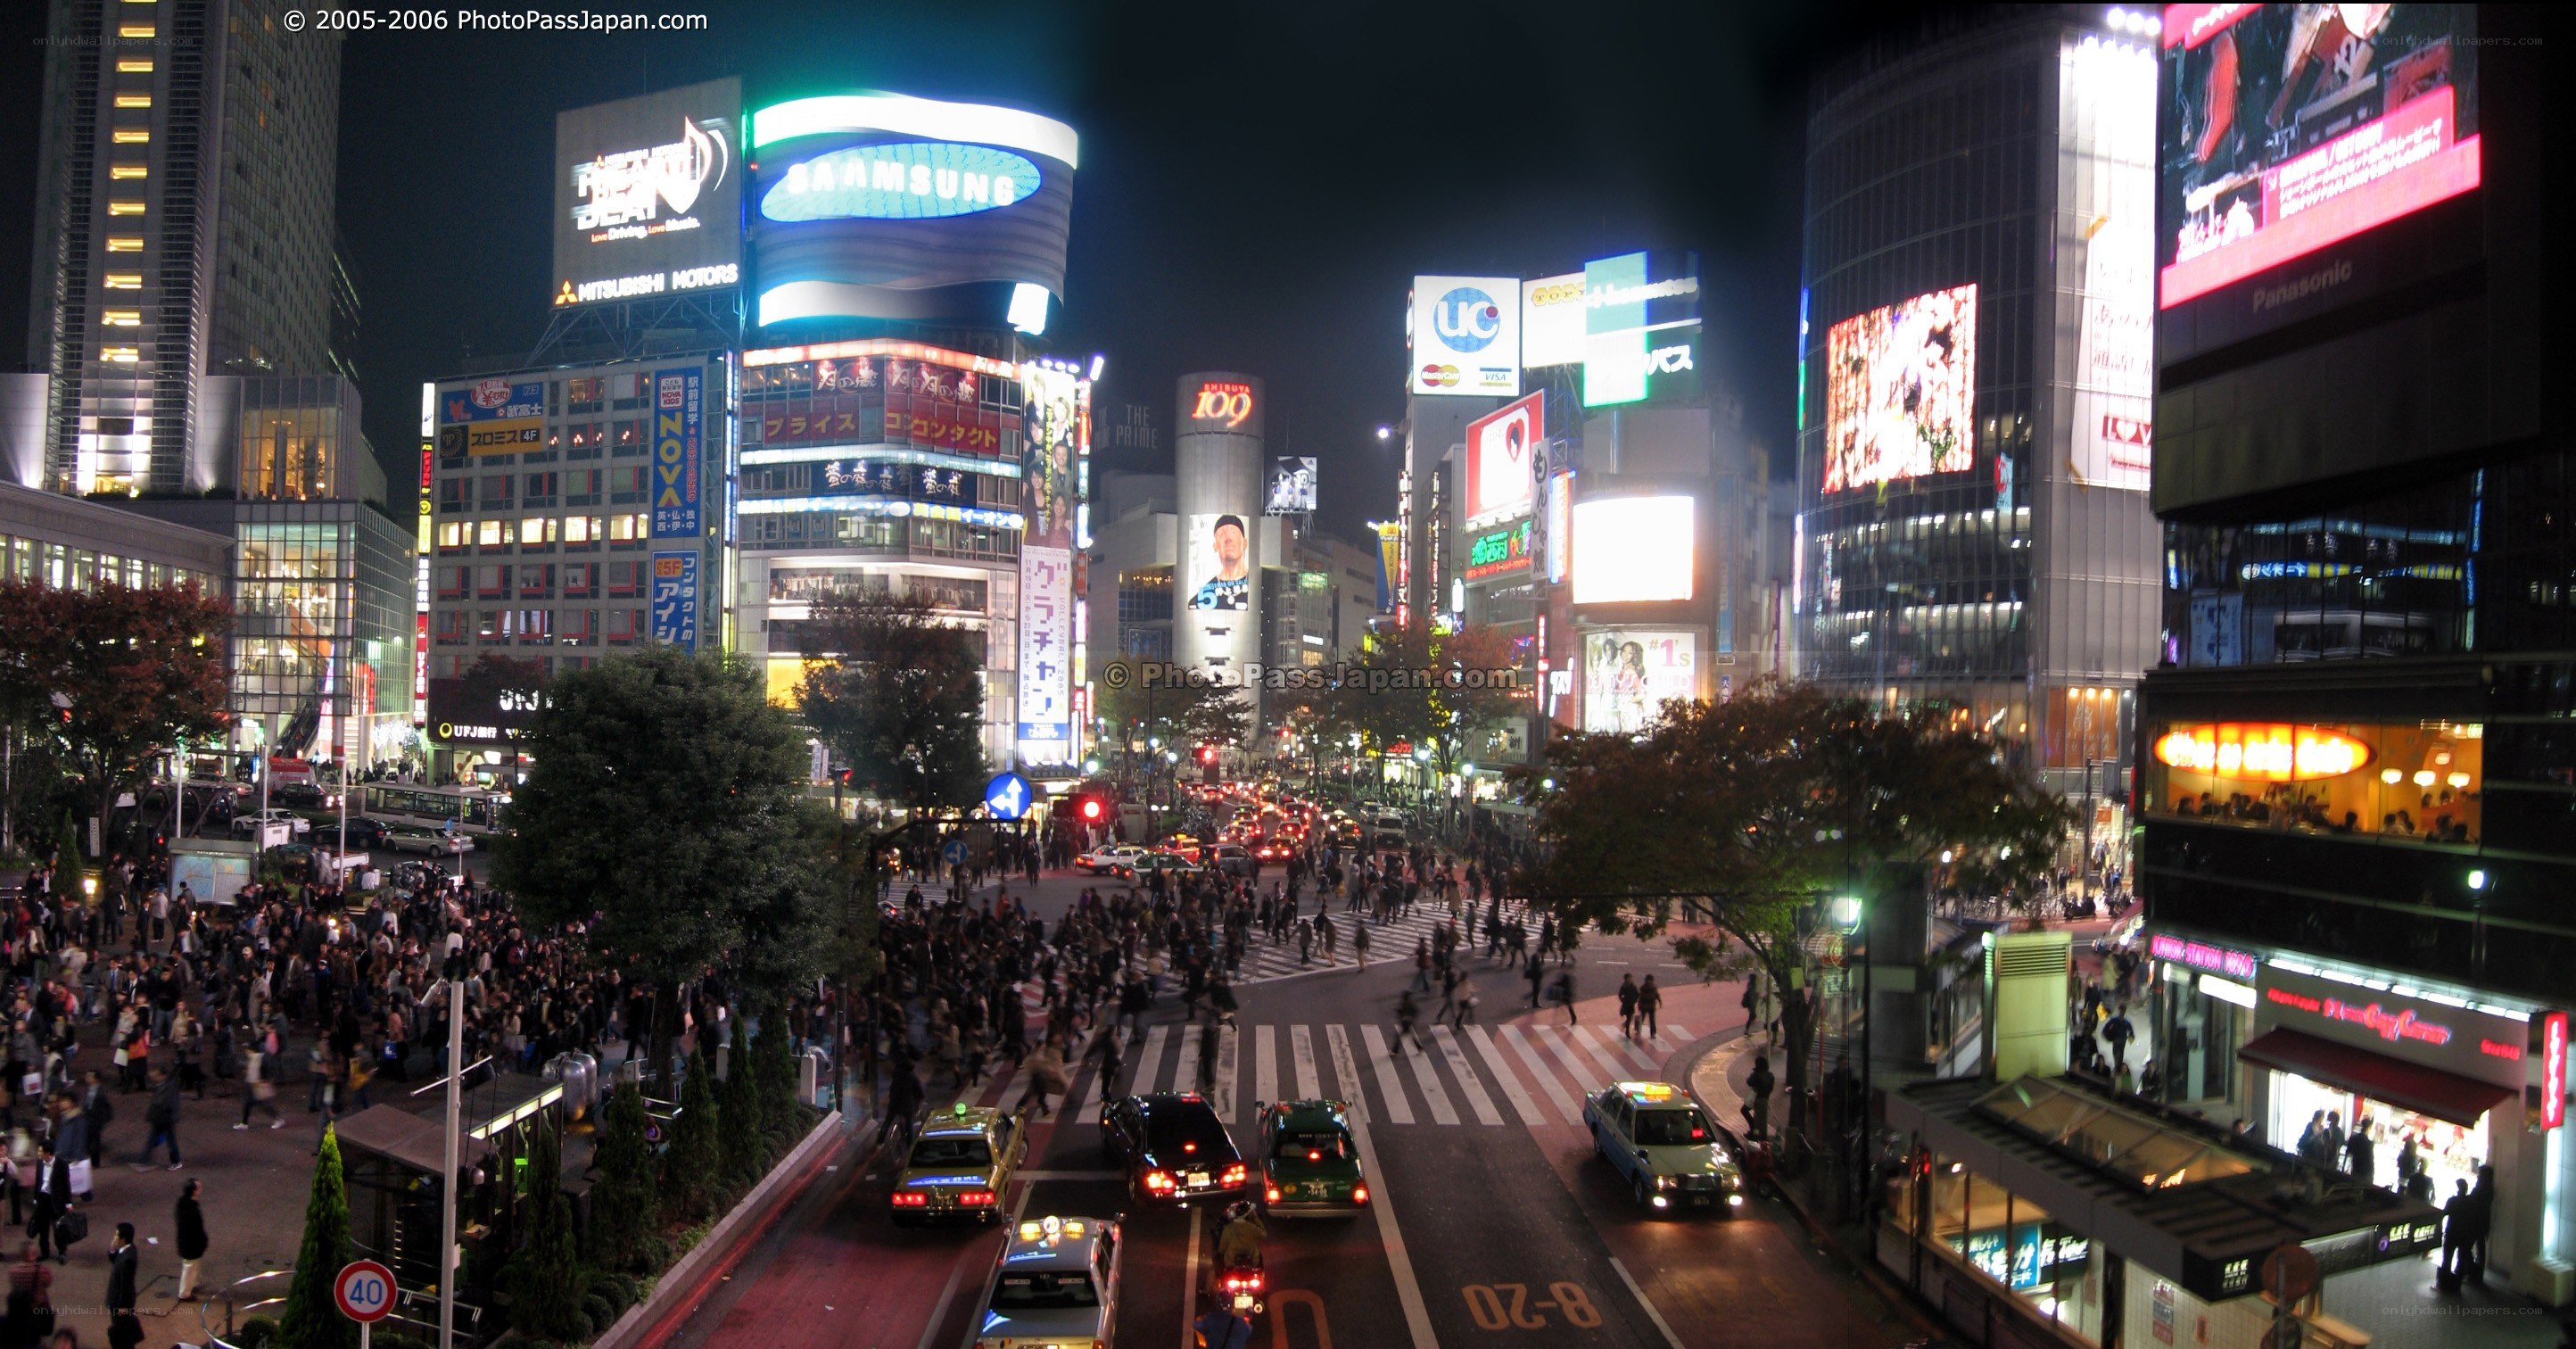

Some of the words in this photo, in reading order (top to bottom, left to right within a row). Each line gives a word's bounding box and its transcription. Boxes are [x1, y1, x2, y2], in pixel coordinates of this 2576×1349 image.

[578, 272, 665, 302] MITSUBISHI
[672, 262, 739, 291] MOTORS
[2252, 259, 2353, 314] Panasonic
[1204, 383, 1251, 393] SHIBUYA
[1484, 372, 1507, 382] VISA
[661, 390, 681, 400] NOVA
[1126, 404, 1151, 426] THE
[1192, 390, 1252, 427] 109
[471, 429, 518, 446] プロミス
[523, 430, 537, 441] 4F
[1116, 425, 1158, 449] PRIME
[657, 410, 683, 508] NOVA
[664, 560, 681, 575] 5F
[681, 557, 696, 640] コンタクトの
[453, 724, 498, 739] UFJ銀行
[349, 1279, 384, 1305] 40
